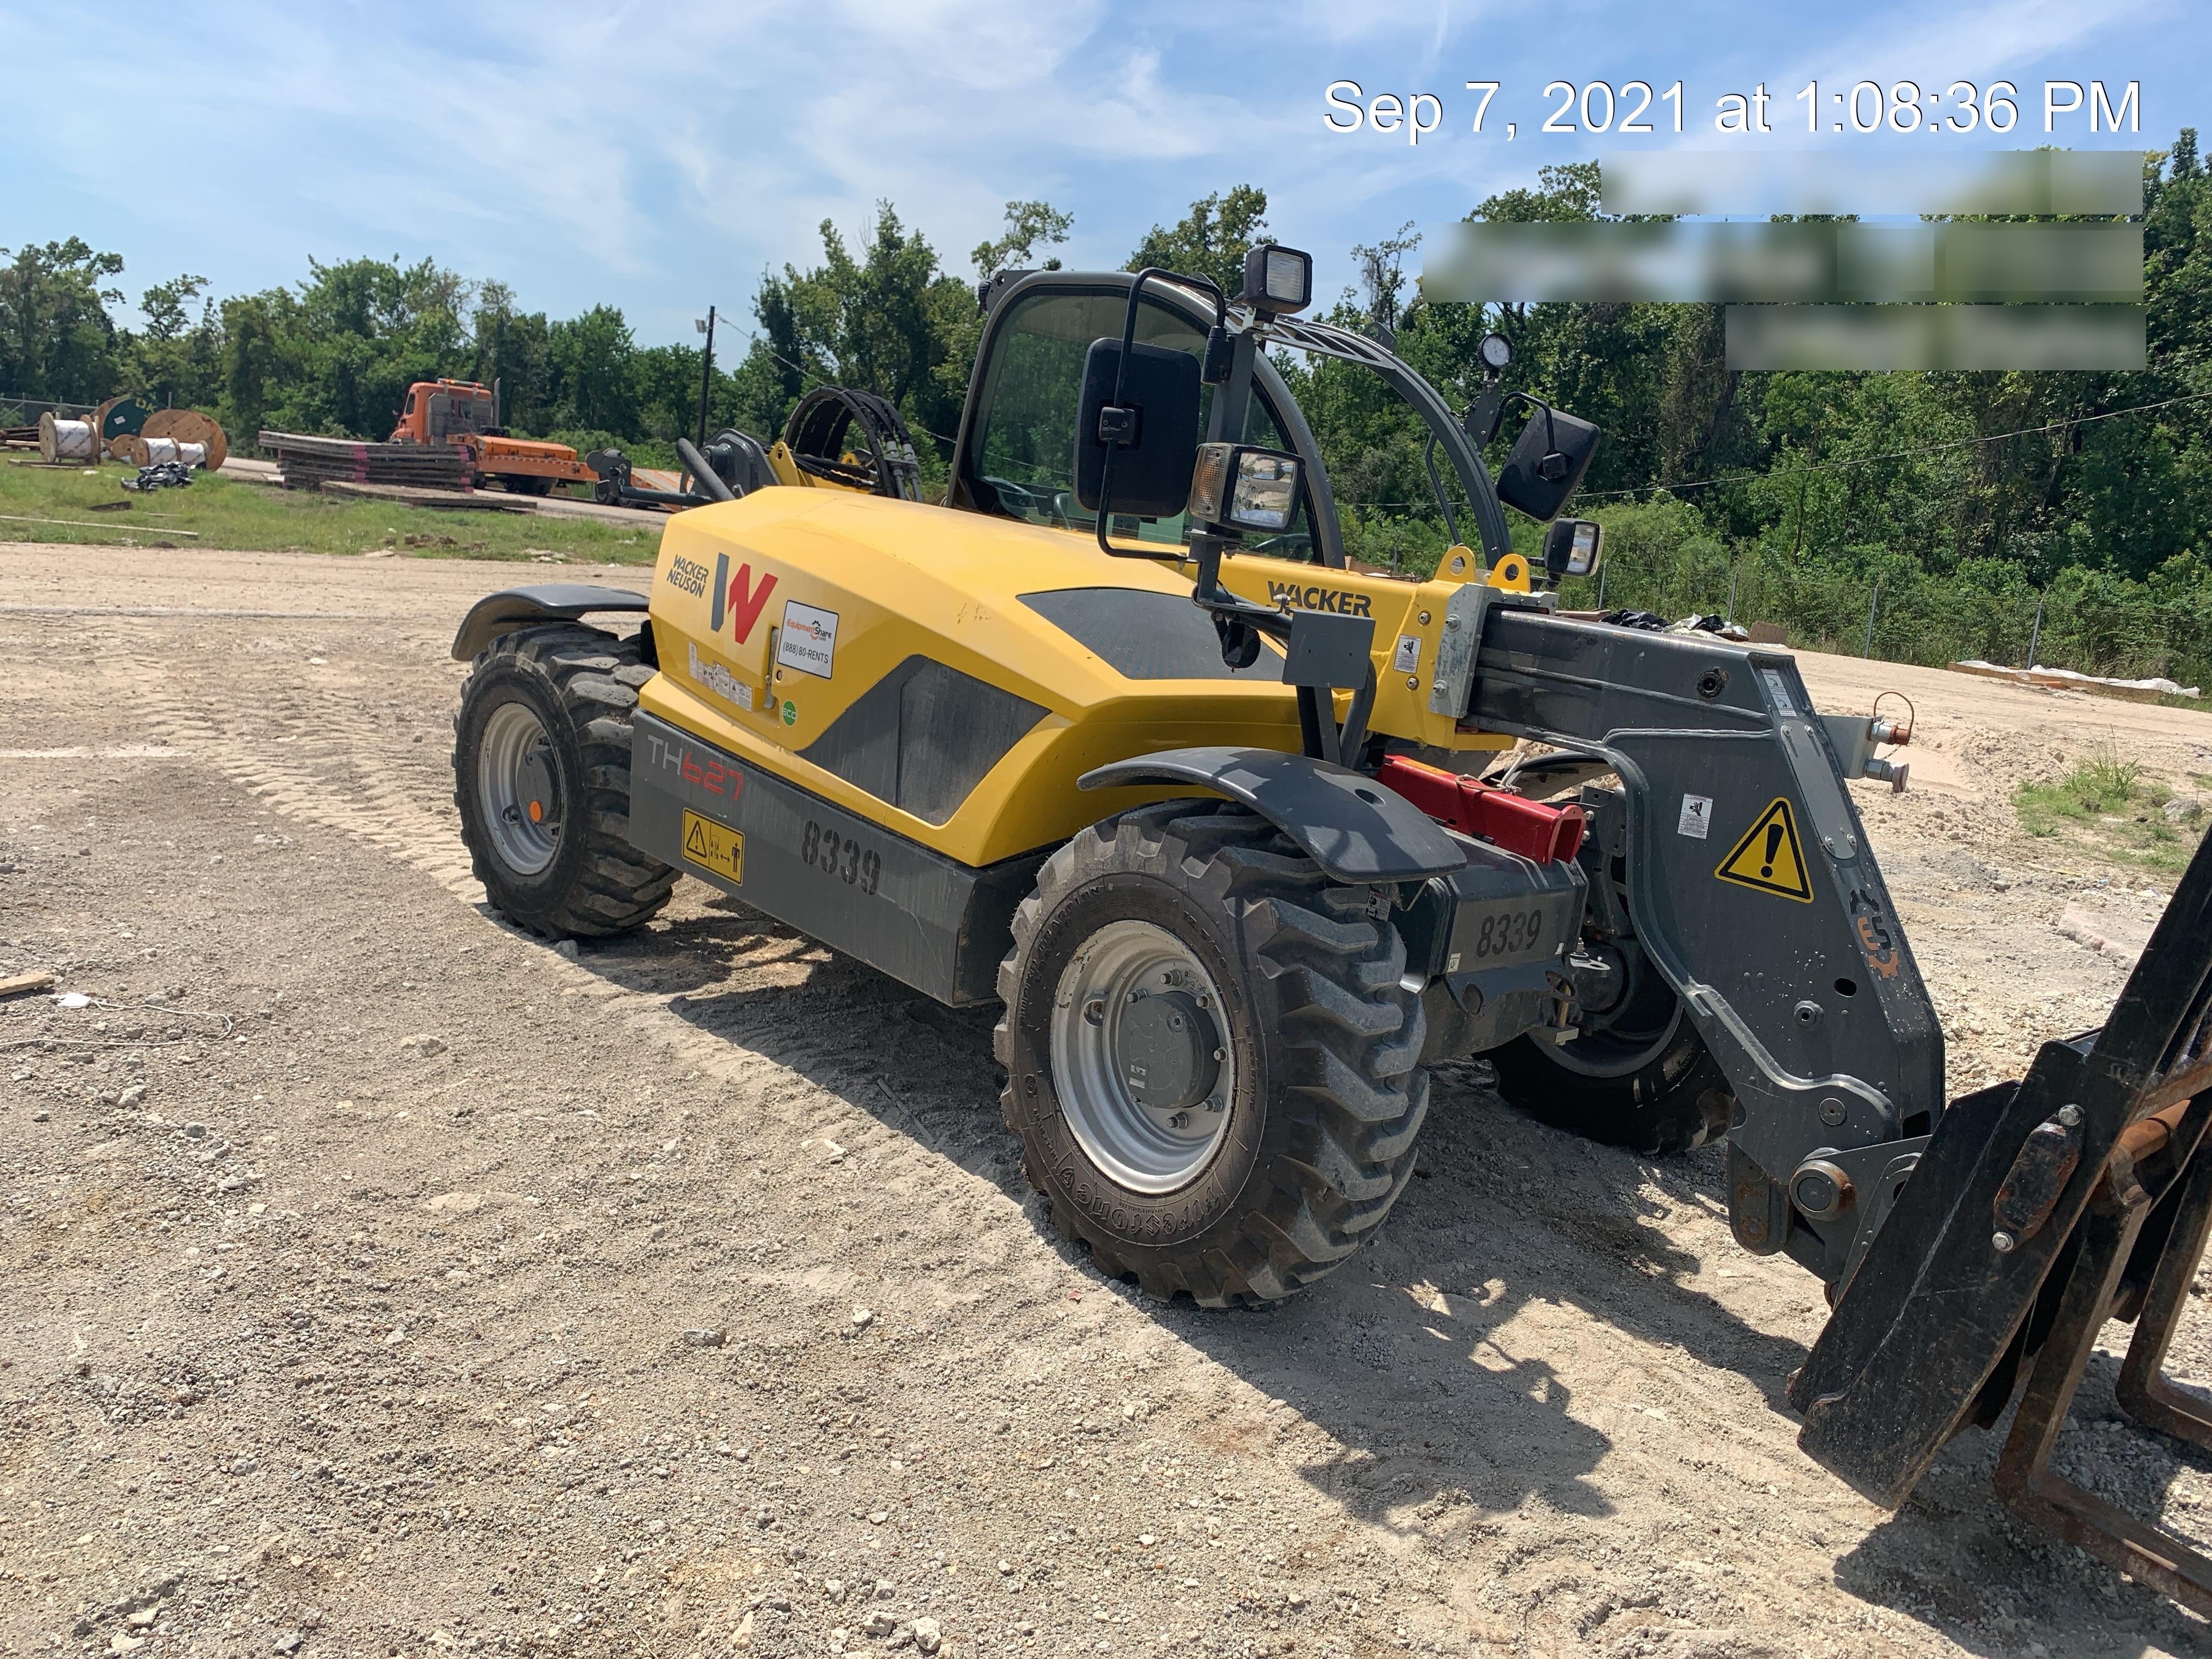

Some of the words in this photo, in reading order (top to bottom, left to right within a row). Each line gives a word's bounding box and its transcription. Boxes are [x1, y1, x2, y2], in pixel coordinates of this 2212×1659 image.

[667, 568, 706, 598] NEUSON
[673, 554, 709, 583] WACKER
[1267, 580, 1372, 618] WACKER
[782, 708, 797, 719] ECO
[647, 734, 743, 802] TH627
[802, 820, 881, 895] 8339
[1476, 909, 1542, 958] 8339
